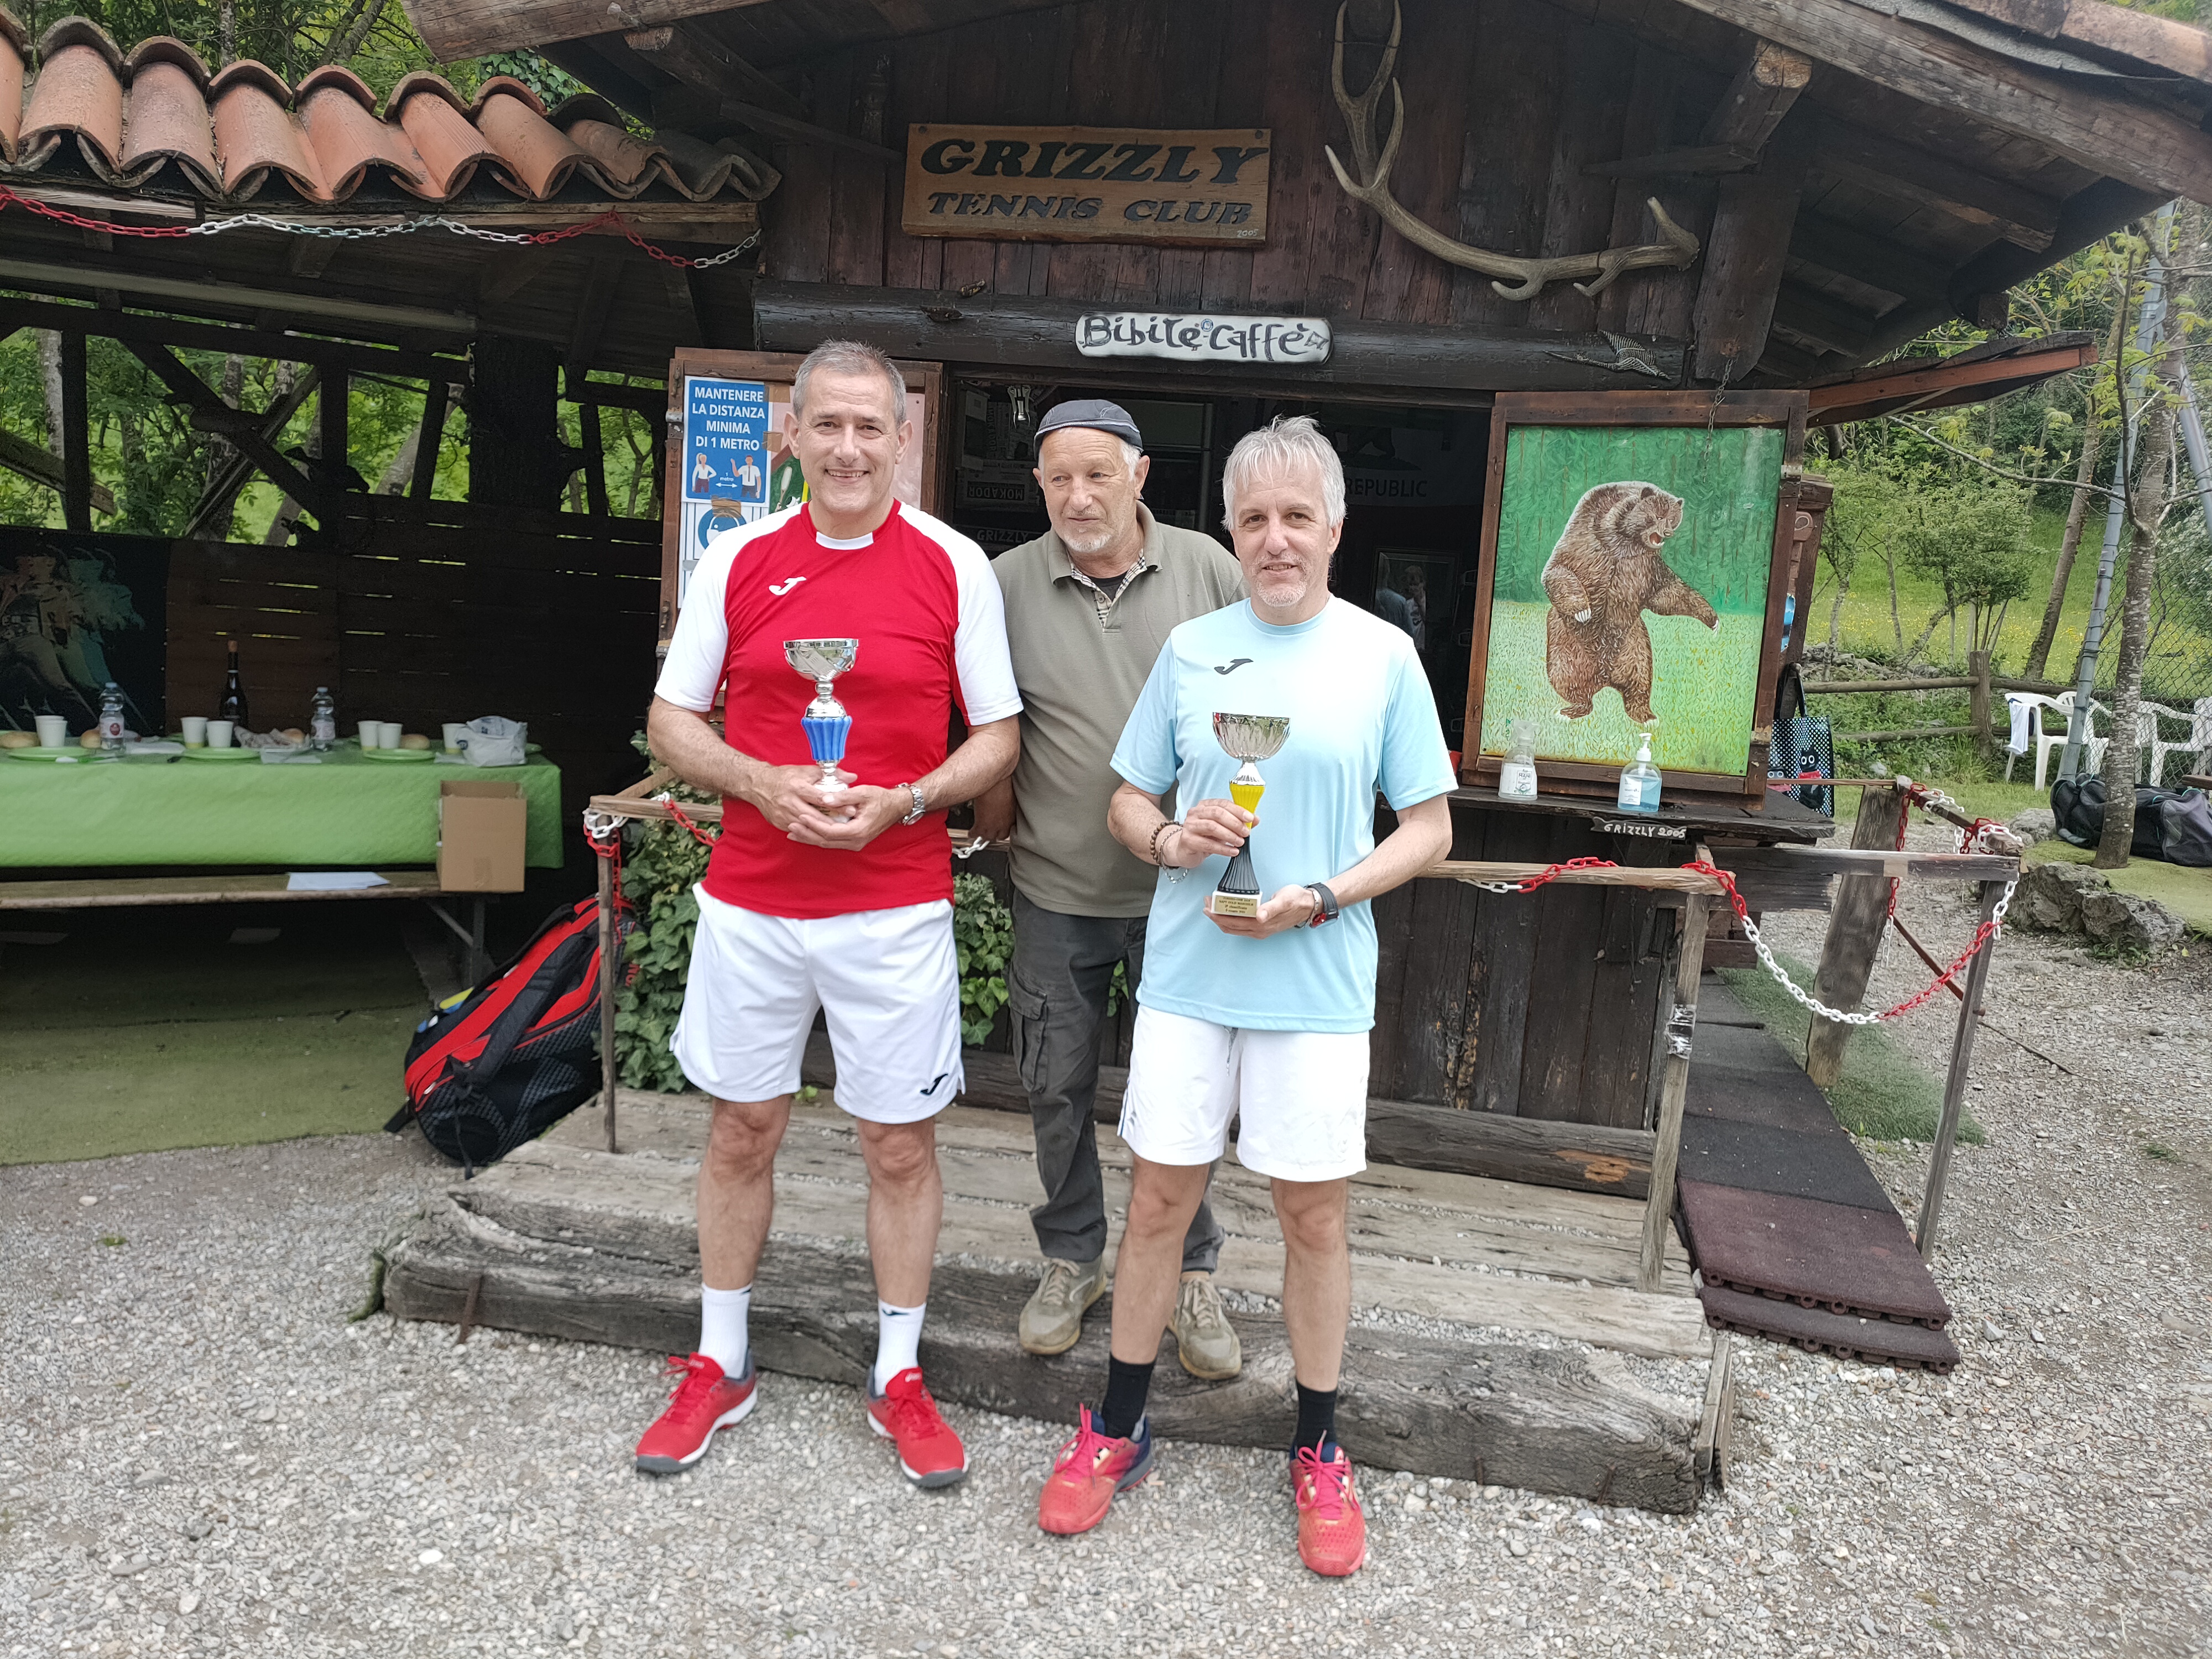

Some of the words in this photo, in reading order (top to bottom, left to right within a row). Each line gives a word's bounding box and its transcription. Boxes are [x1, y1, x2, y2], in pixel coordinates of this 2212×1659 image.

[920, 138, 1269, 184] GRIZZLY
[927, 192, 1103, 220] TENNIS
[1124, 200, 1253, 225] CLUB
[1236, 228, 1259, 238] 2005
[695, 387, 763, 402] MANTENERE
[692, 403, 707, 414] LA
[709, 404, 765, 419] DISTANZA
[706, 420, 750, 434] MINIMA
[696, 436, 708, 447] DI
[711, 437, 716, 448] 1
[720, 437, 760, 451] METRO
[968, 487, 1024, 500] MOKADOR
[1345, 477, 1428, 497] REPUBLIC
[977, 529, 1029, 544] GRIZZLY
[1657, 827, 1687, 838] 2005
